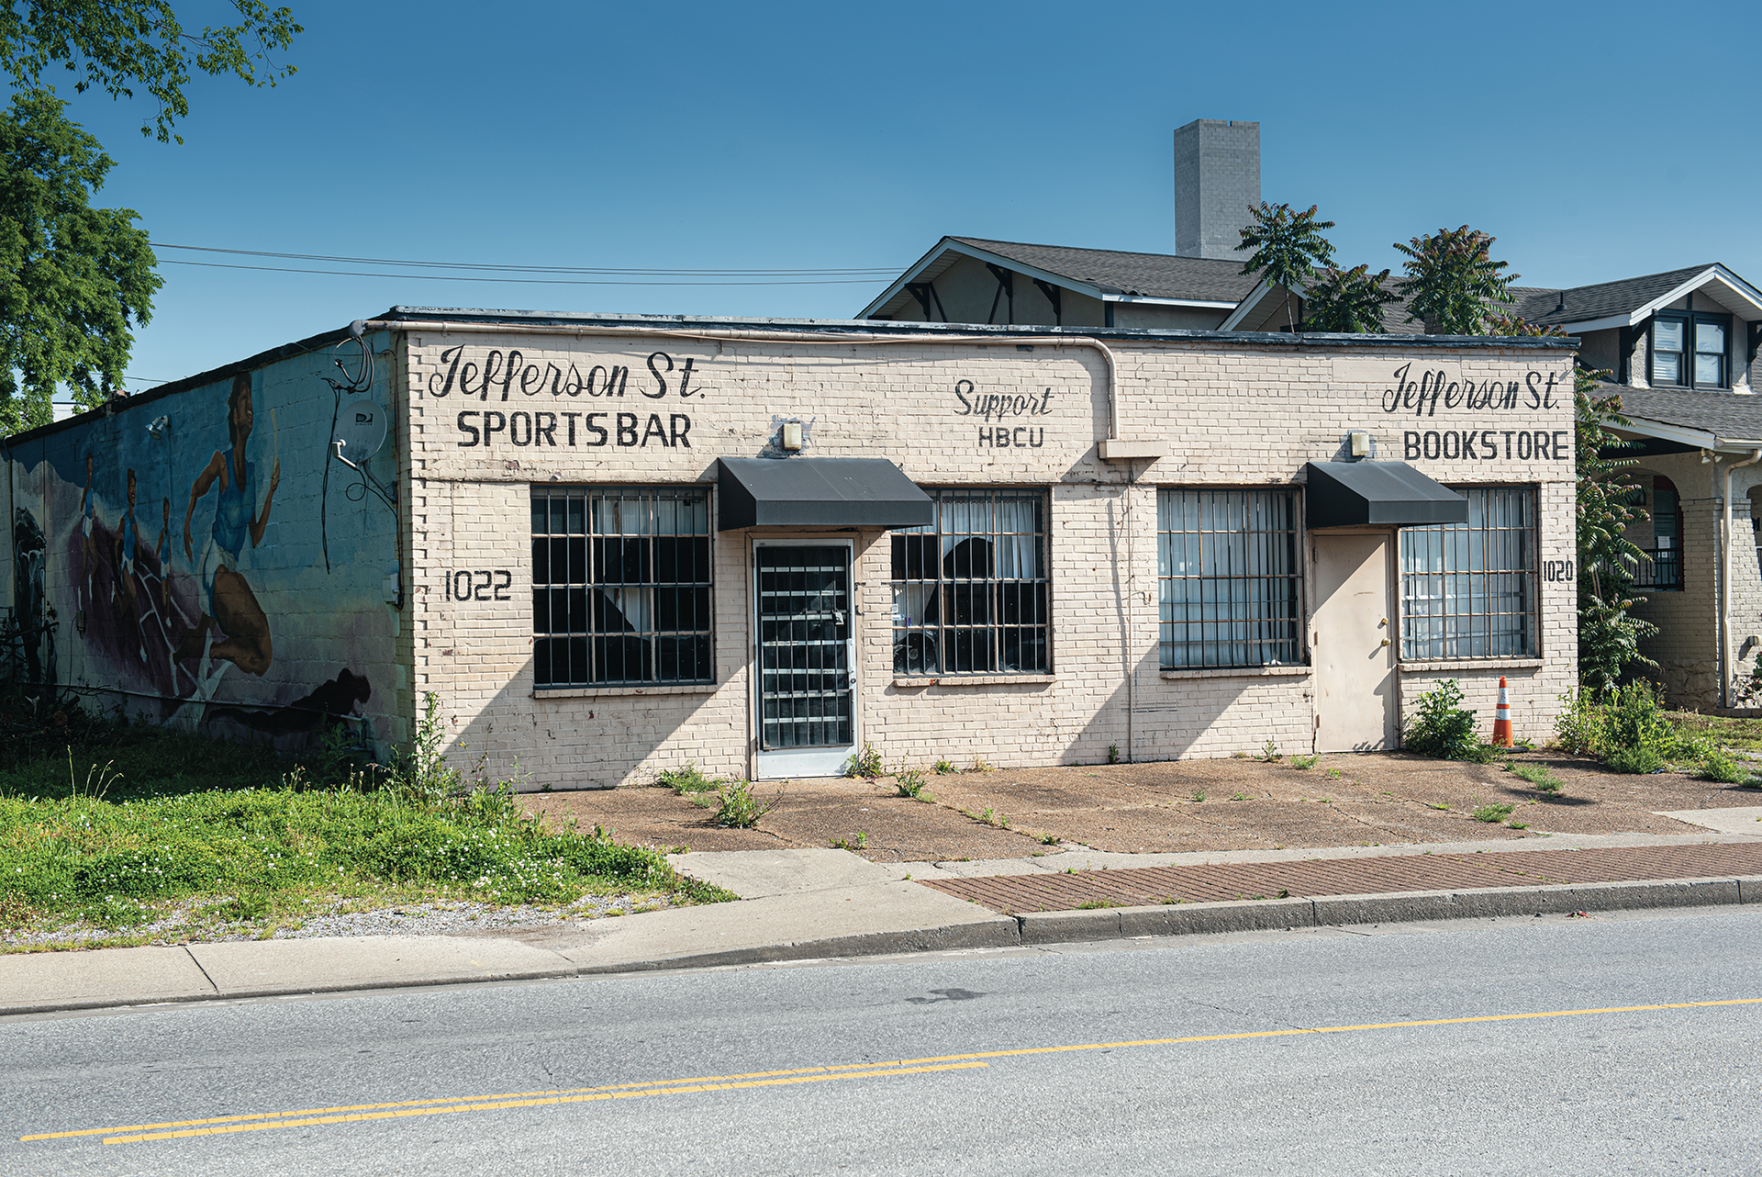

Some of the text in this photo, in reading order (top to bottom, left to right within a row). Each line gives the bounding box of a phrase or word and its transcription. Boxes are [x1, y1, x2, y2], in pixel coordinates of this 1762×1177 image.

[428, 343, 706, 402] Jefferson St.
[953, 379, 1055, 423] Support
[1382, 361, 1560, 417] Jefferson St.
[978, 426, 1044, 448] HBCU
[1403, 430, 1570, 461] BOOKSTORE
[445, 570, 512, 602] 1022
[1543, 560, 1573, 582] 1020
